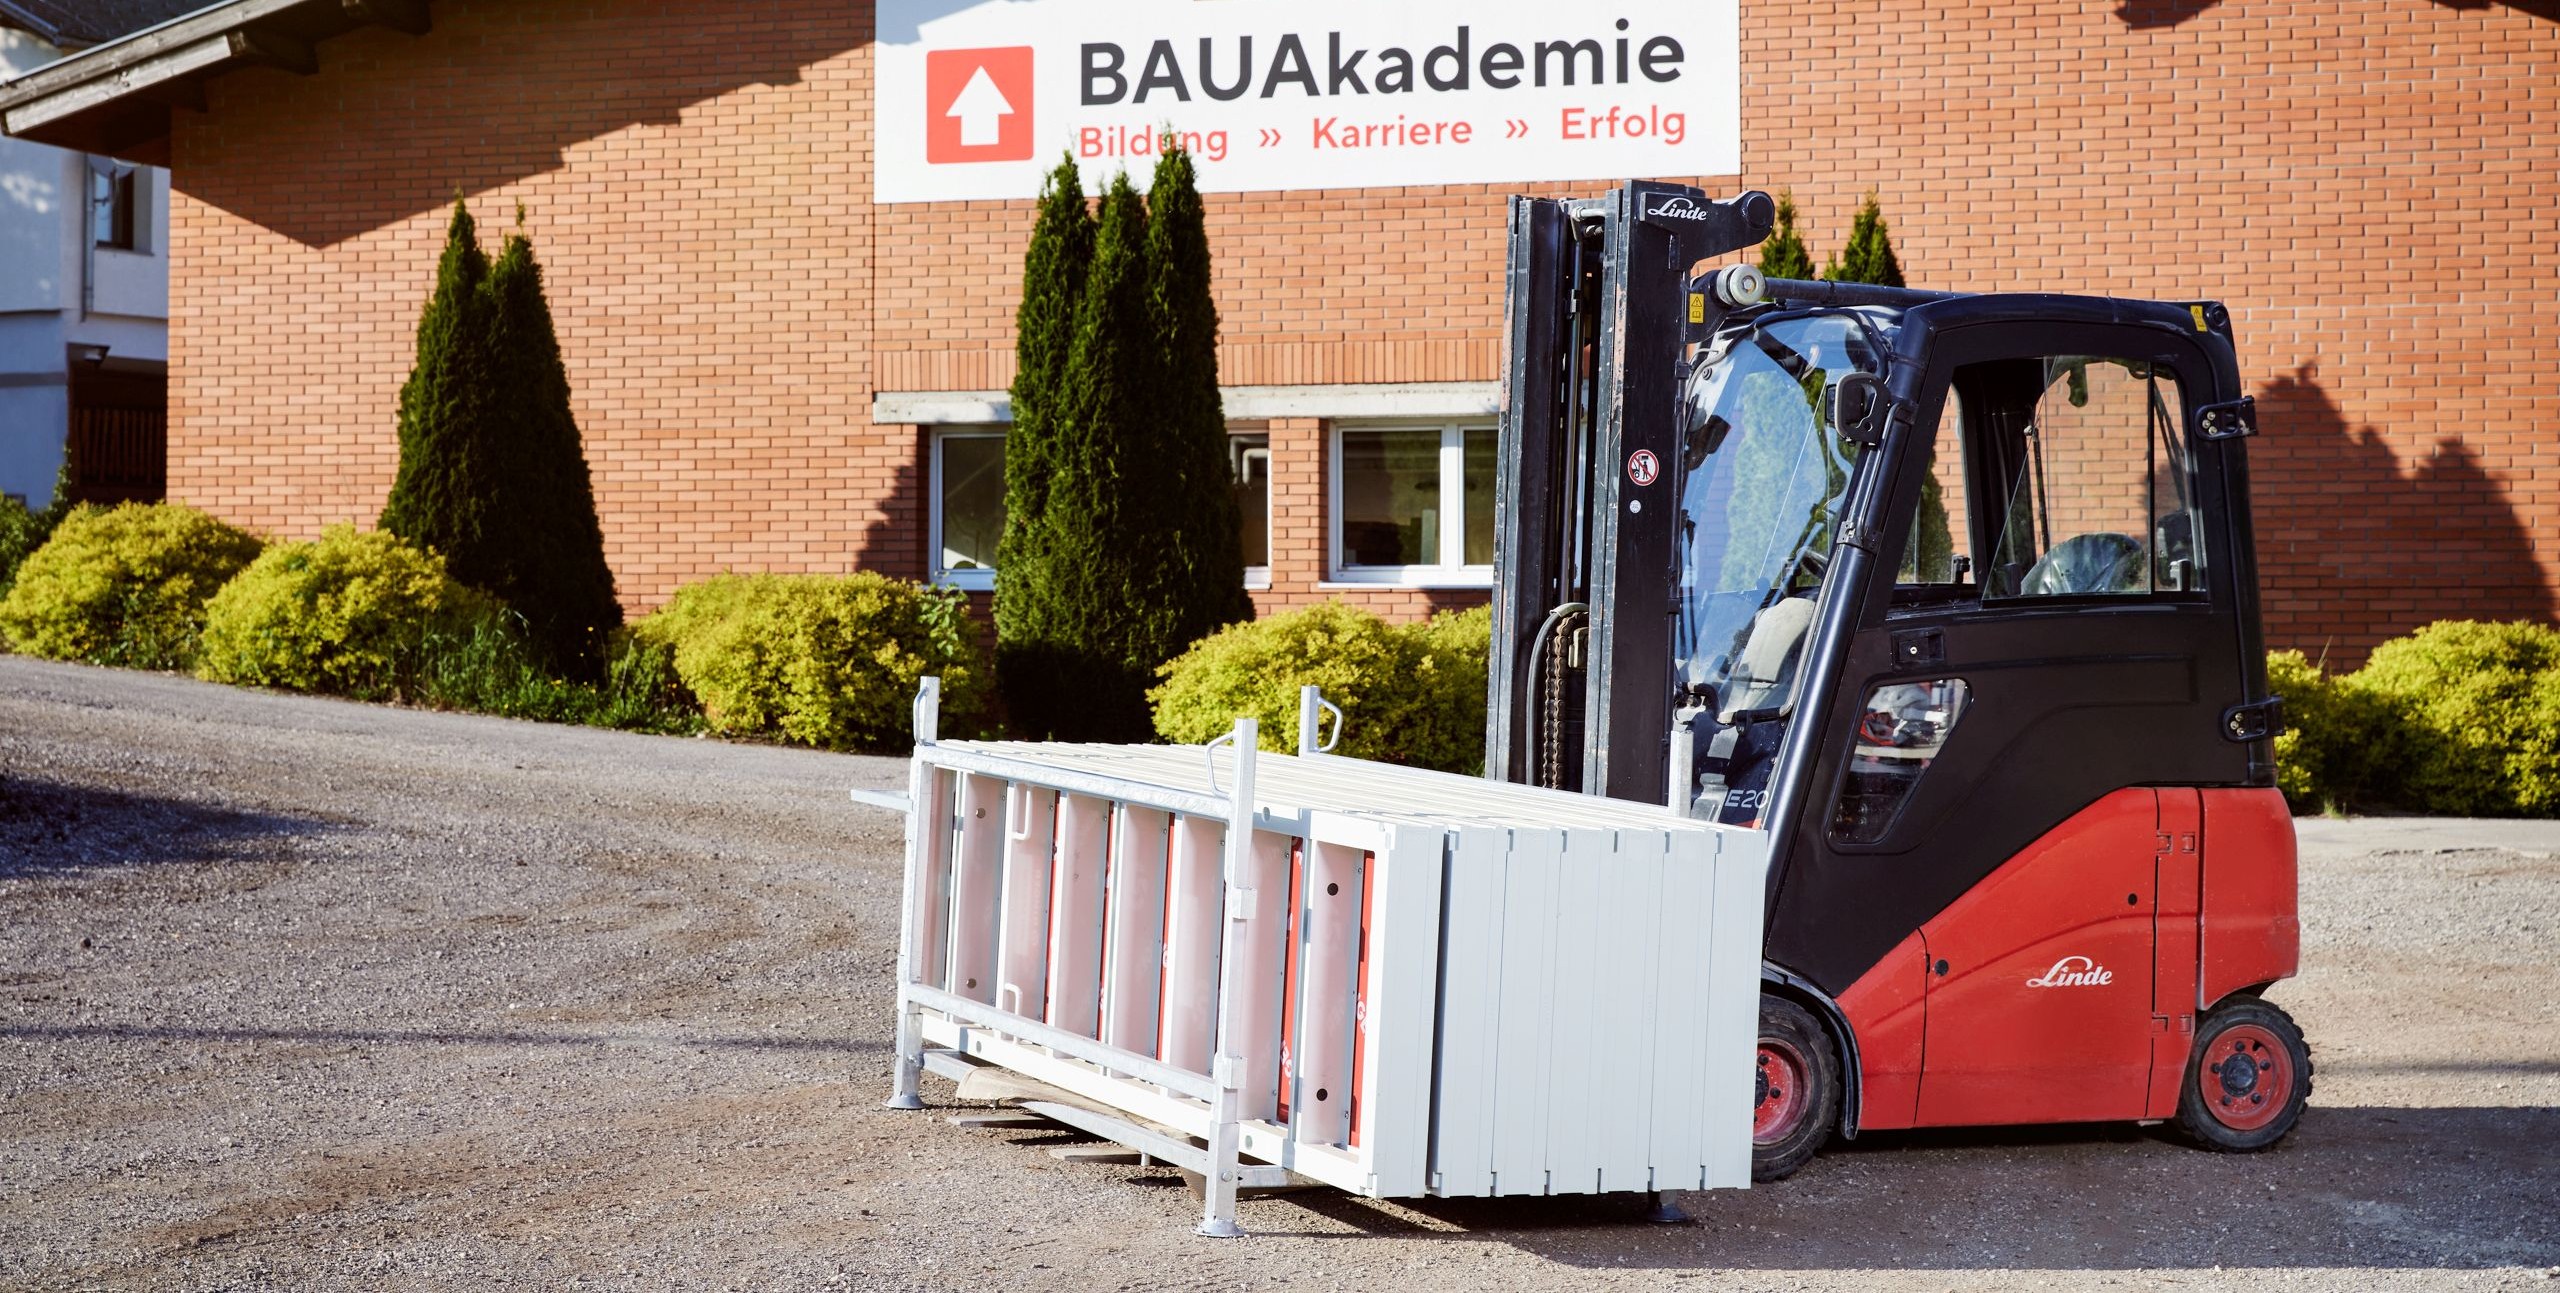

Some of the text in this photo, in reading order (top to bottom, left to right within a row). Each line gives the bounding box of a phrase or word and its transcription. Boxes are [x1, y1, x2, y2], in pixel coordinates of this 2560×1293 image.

[1080, 17, 1686, 106] BAUAkademie
[1079, 124, 1229, 162] Bildung
[1313, 113, 1473, 150] Karriere
[1561, 104, 1686, 146] Erfolg
[1647, 197, 1708, 221] Linde
[2025, 955, 2113, 988] Linde
